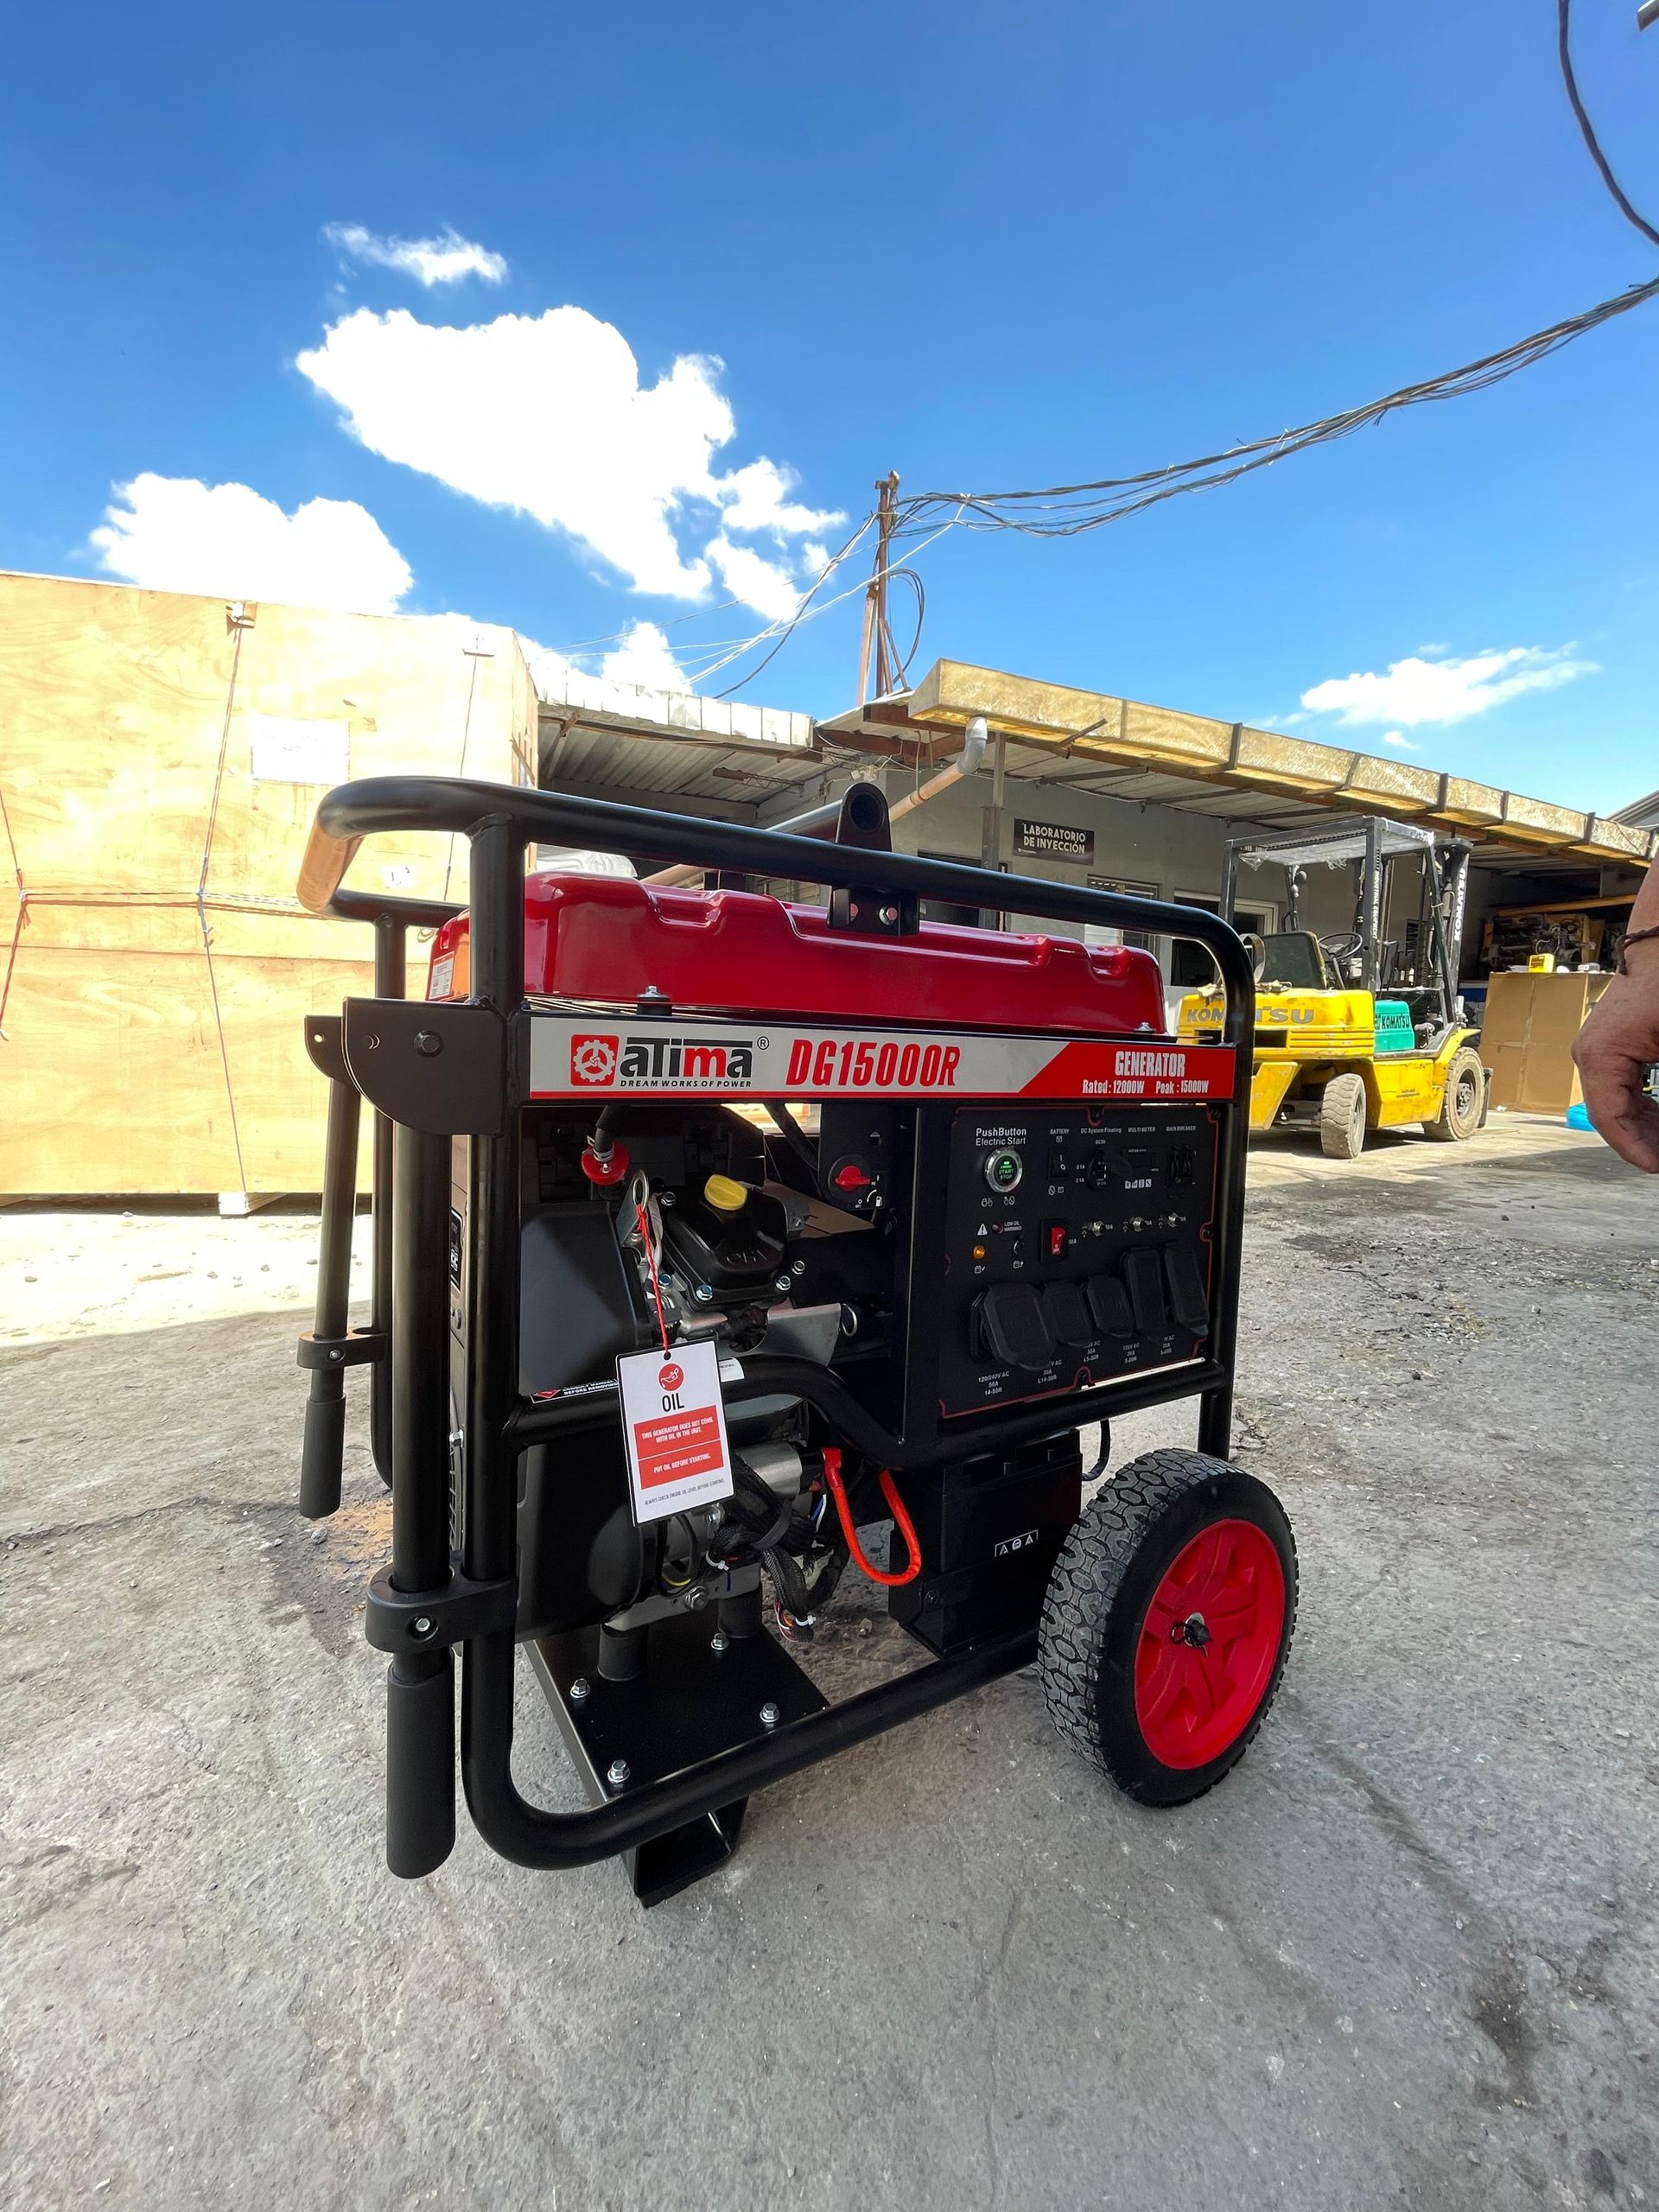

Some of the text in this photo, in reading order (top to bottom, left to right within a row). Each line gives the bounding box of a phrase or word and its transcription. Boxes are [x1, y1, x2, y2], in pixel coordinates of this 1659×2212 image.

[1023, 823, 1086, 842] LABORATORIO
[1023, 836, 1035, 847] DE
[1037, 838, 1085, 855] INYECCIÓN
[1382, 1013, 1409, 1029] KOMATSU
[785, 1039, 961, 1087] DG15000R
[1115, 1051, 1186, 1077] GENERATOR
[1113, 1080, 1145, 1093] 12000W
[976, 1127, 1027, 1137] PushButton
[976, 1136, 1027, 1146] Electric Start
[662, 1393, 684, 1412] OIL
[641, 1431, 653, 1440] THIS
[652, 1425, 679, 1437] GENERATOR
[678, 1421, 691, 1431] DOES
[701, 1416, 714, 1425] COME
[656, 1434, 669, 1444] WITH
[653, 1465, 663, 1474] PUT
[671, 1459, 690, 1469] BEFORE
